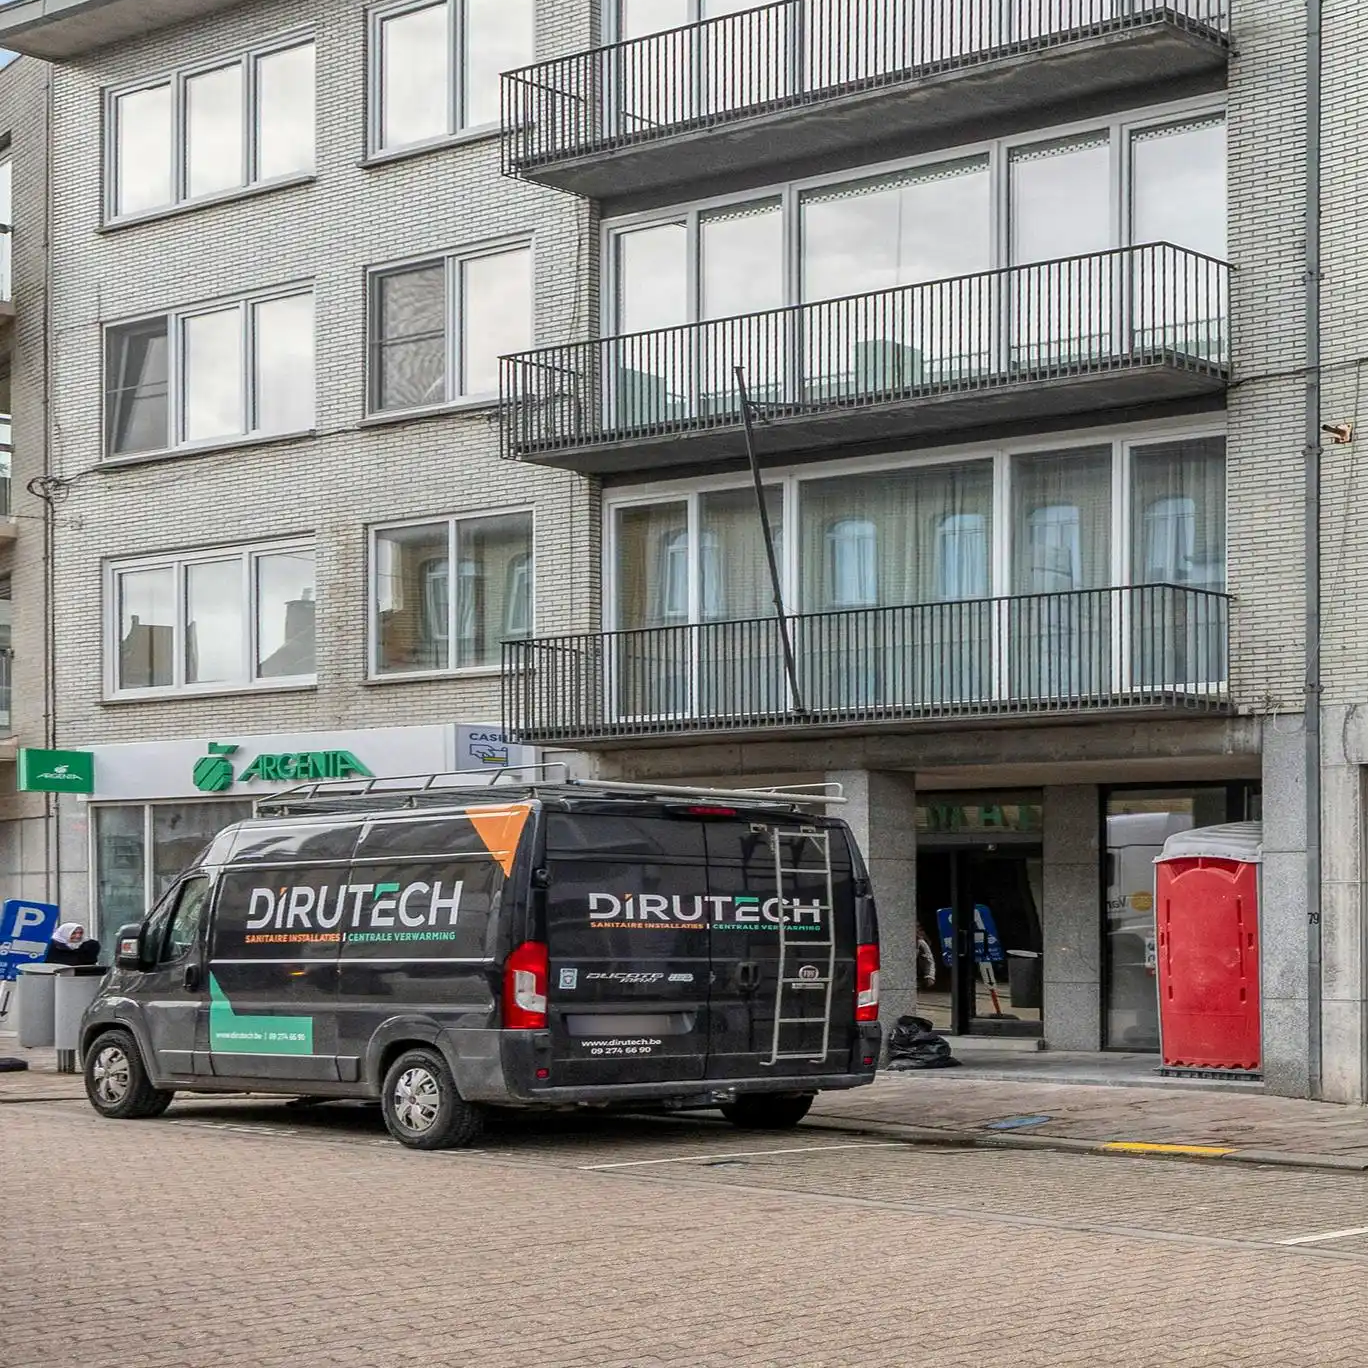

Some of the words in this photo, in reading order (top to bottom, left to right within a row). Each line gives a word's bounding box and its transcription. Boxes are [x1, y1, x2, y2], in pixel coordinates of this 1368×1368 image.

[237, 750, 377, 781] ARGENTA
[246, 881, 464, 929] DIRUTECH
[588, 892, 821, 923] DIRUTECH
[1307, 912, 1320, 924] 79
[11, 907, 45, 937] P
[245, 934, 289, 943] SANITAIRE
[289, 933, 342, 943] INSTALLATIES
[348, 932, 393, 942] CENTRALE
[394, 932, 456, 941] VERWARMING
[581, 1039, 662, 1047] www.dirutech.be
